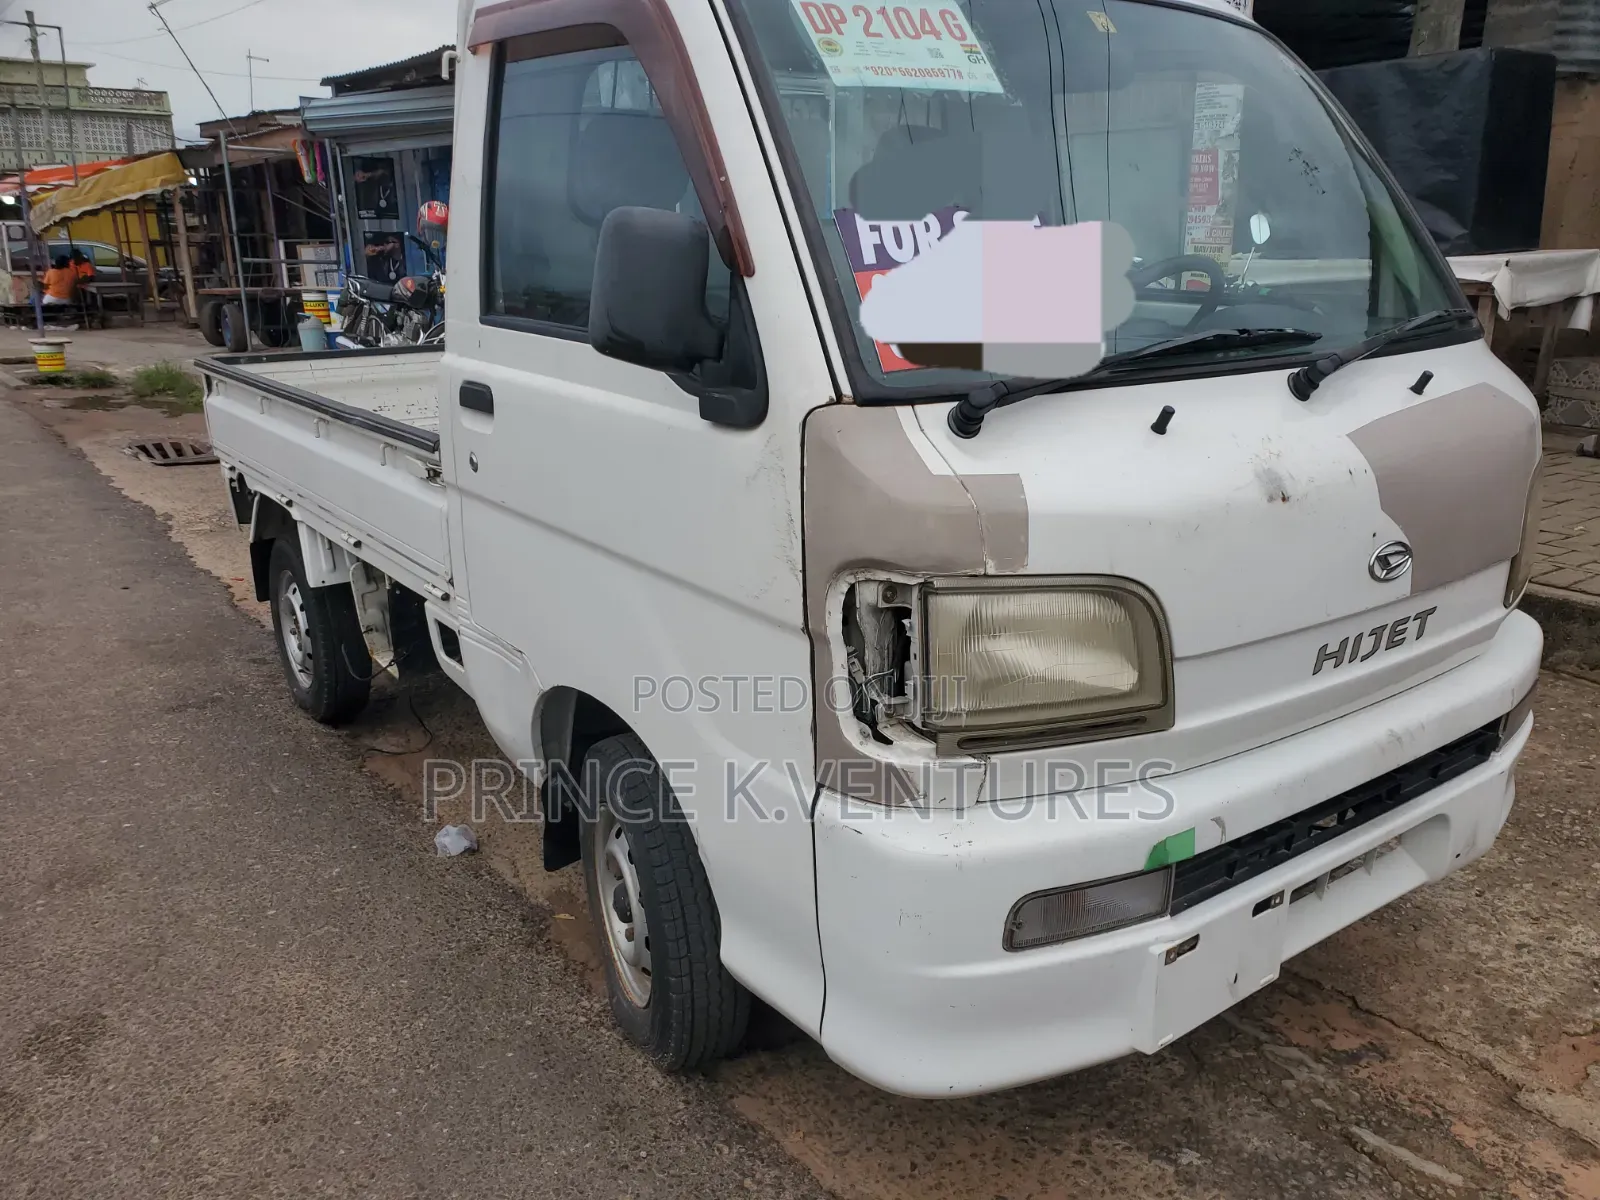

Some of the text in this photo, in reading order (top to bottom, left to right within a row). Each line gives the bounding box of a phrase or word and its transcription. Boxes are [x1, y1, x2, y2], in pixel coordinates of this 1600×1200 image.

[800, 2, 968, 41] DP 2104 G
[967, 54, 987, 64] GH
[854, 212, 942, 265] FOR
[1312, 605, 1438, 676] HIJET
